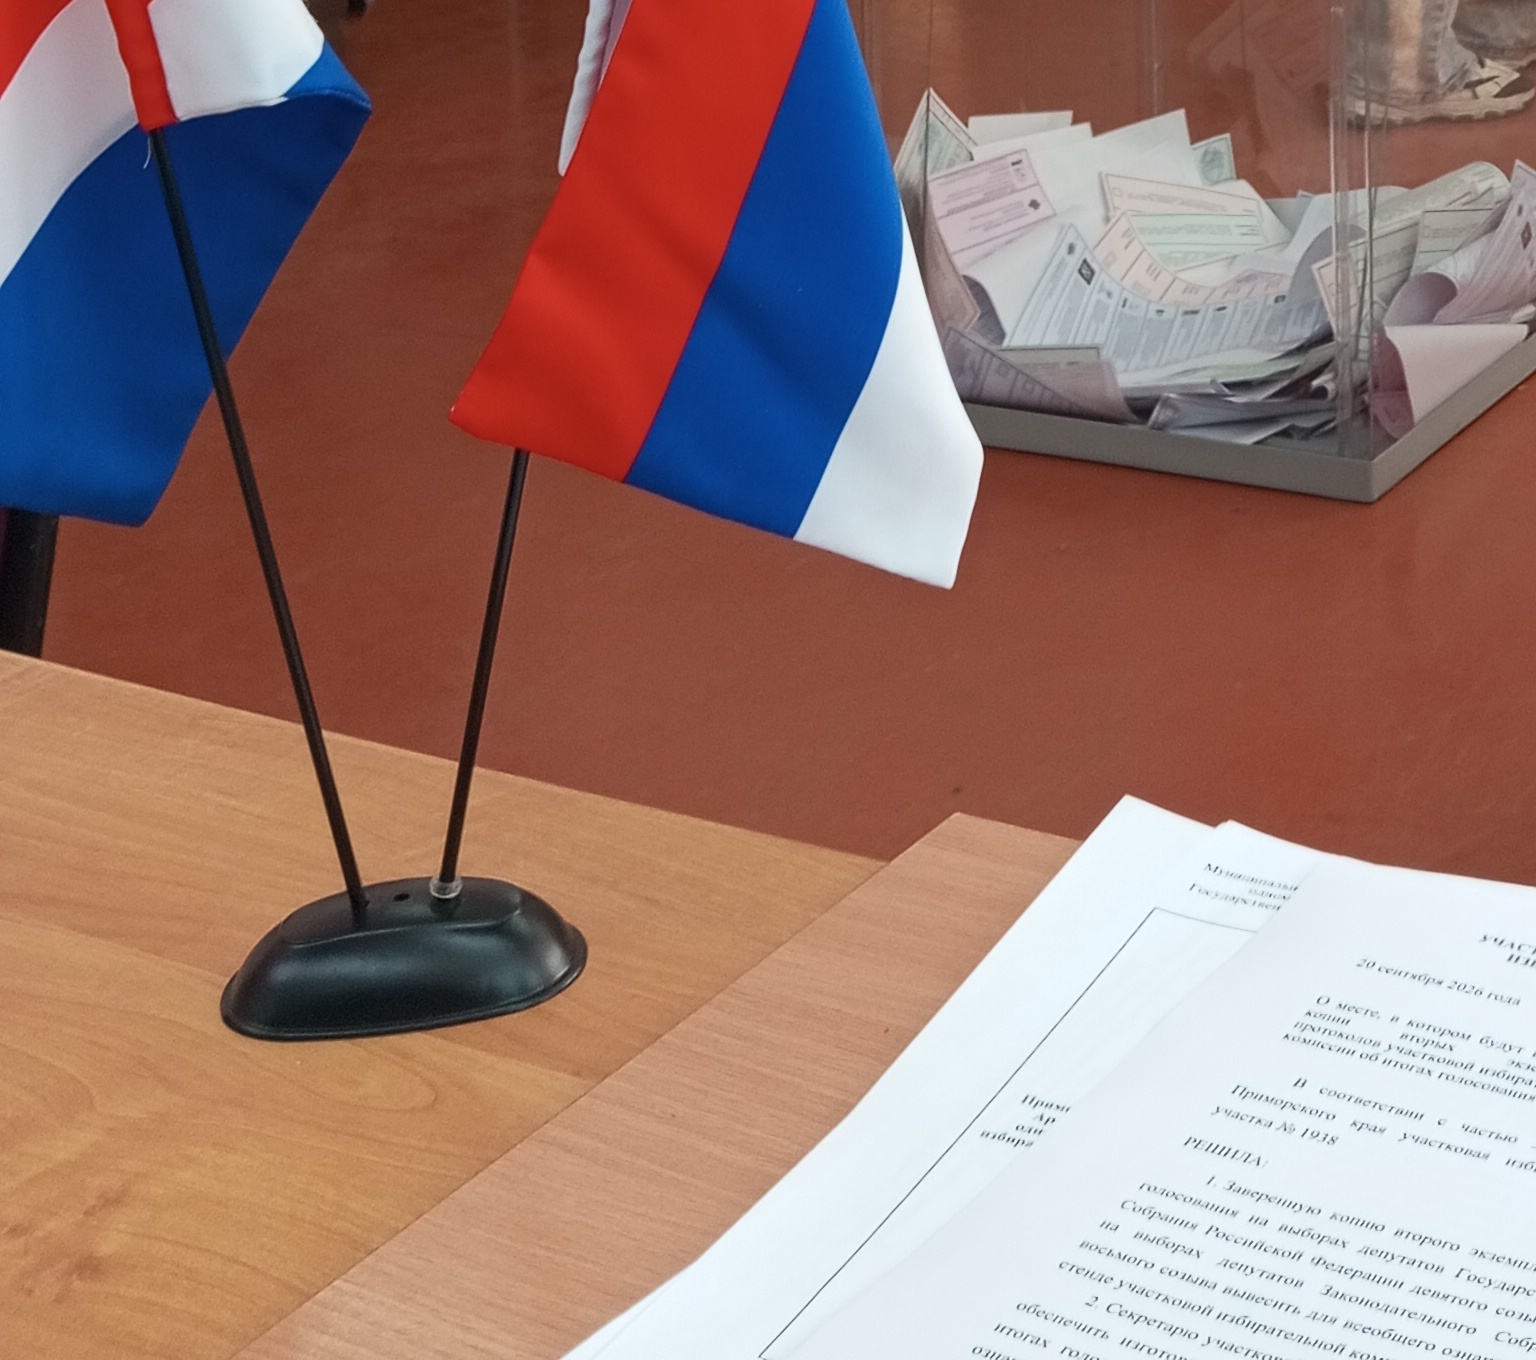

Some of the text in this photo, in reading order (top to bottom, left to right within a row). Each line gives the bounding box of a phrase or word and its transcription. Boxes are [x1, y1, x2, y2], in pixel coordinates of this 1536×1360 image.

[1356, 958, 1522, 1007] 20 сентября 2026 года
[1294, 1020, 1382, 1049] протоколов
[1385, 1040, 1476, 1072] участковой
[1336, 1001, 1381, 1020] месте,
[1406, 1018, 1472, 1042] котором
[1479, 1034, 1525, 1056] будут
[1399, 1031, 1455, 1054] вторых
[1283, 1032, 1536, 1103] комиссии об итогах голосования
[1210, 1104, 1274, 1130] участка
[1299, 1126, 1340, 1147] 1938
[1231, 1083, 1337, 1123] Приморского
[1349, 1118, 1387, 1136] края
[1398, 1130, 1492, 1162] участковая
[1318, 1085, 1426, 1122] соответствии
[1436, 1117, 1448, 1127] с
[1460, 1122, 1519, 1145] частью
[1138, 1181, 1241, 1220] голосования
[1246, 1213, 1270, 1229] на
[1277, 1221, 1351, 1251] выборах
[1356, 1243, 1446, 1276] депутатов
[1222, 1178, 1323, 1218] Заверенную
[1329, 1209, 1387, 1233] копию
[1393, 1227, 1461, 1253] второго
[1098, 1218, 1121, 1233] на
[1132, 1230, 1206, 1260] выборах
[1216, 1256, 1306, 1290] депутатов
[1319, 1283, 1479, 1336] Законодательного
[1119, 1198, 1200, 1233] Собрания
[1204, 1224, 1305, 1264] Российской
[1310, 1254, 1406, 1291] Федерации
[1409, 1282, 1489, 1314] девятого
[1016, 1300, 1112, 1341] обеспечить
[1058, 1258, 1115, 1286] стенде
[1112, 1278, 1214, 1319] участковой
[1216, 1308, 1348, 1356] избирательной
[1079, 1238, 1156, 1272] восьмого
[1158, 1264, 1219, 1292] созыва
[1221, 1282, 1303, 1316] вывесить
[1305, 1309, 1339, 1327] для
[1342, 1319, 1437, 1353] всеобщего
[1104, 1301, 1200, 1342] Секретарю
[993, 1321, 1053, 1349] итогах
